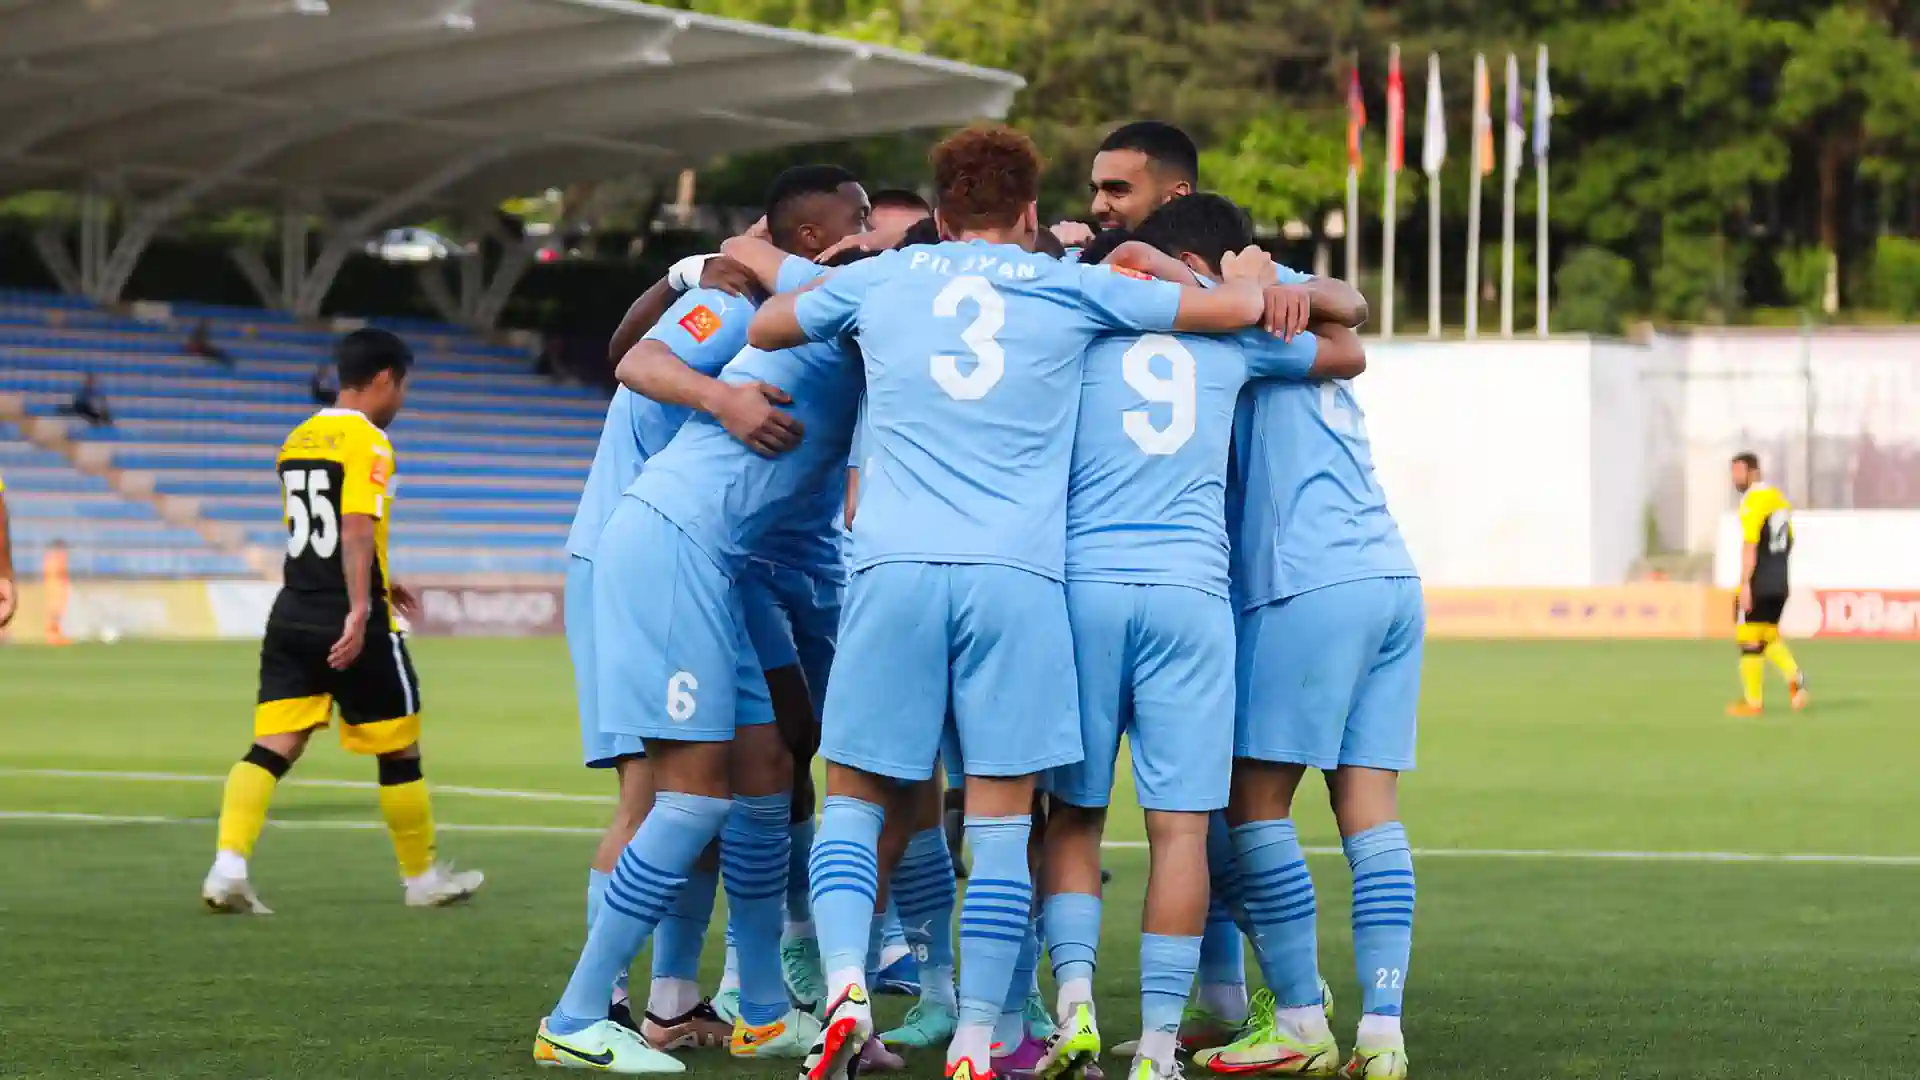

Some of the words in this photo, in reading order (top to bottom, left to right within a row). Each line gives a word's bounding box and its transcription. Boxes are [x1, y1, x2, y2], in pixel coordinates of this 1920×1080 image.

[929, 275, 1005, 401] 3
[1122, 333, 1196, 456] 9
[284, 469, 339, 559] 55
[666, 670, 699, 722] 6
[1375, 967, 1401, 989] 22
